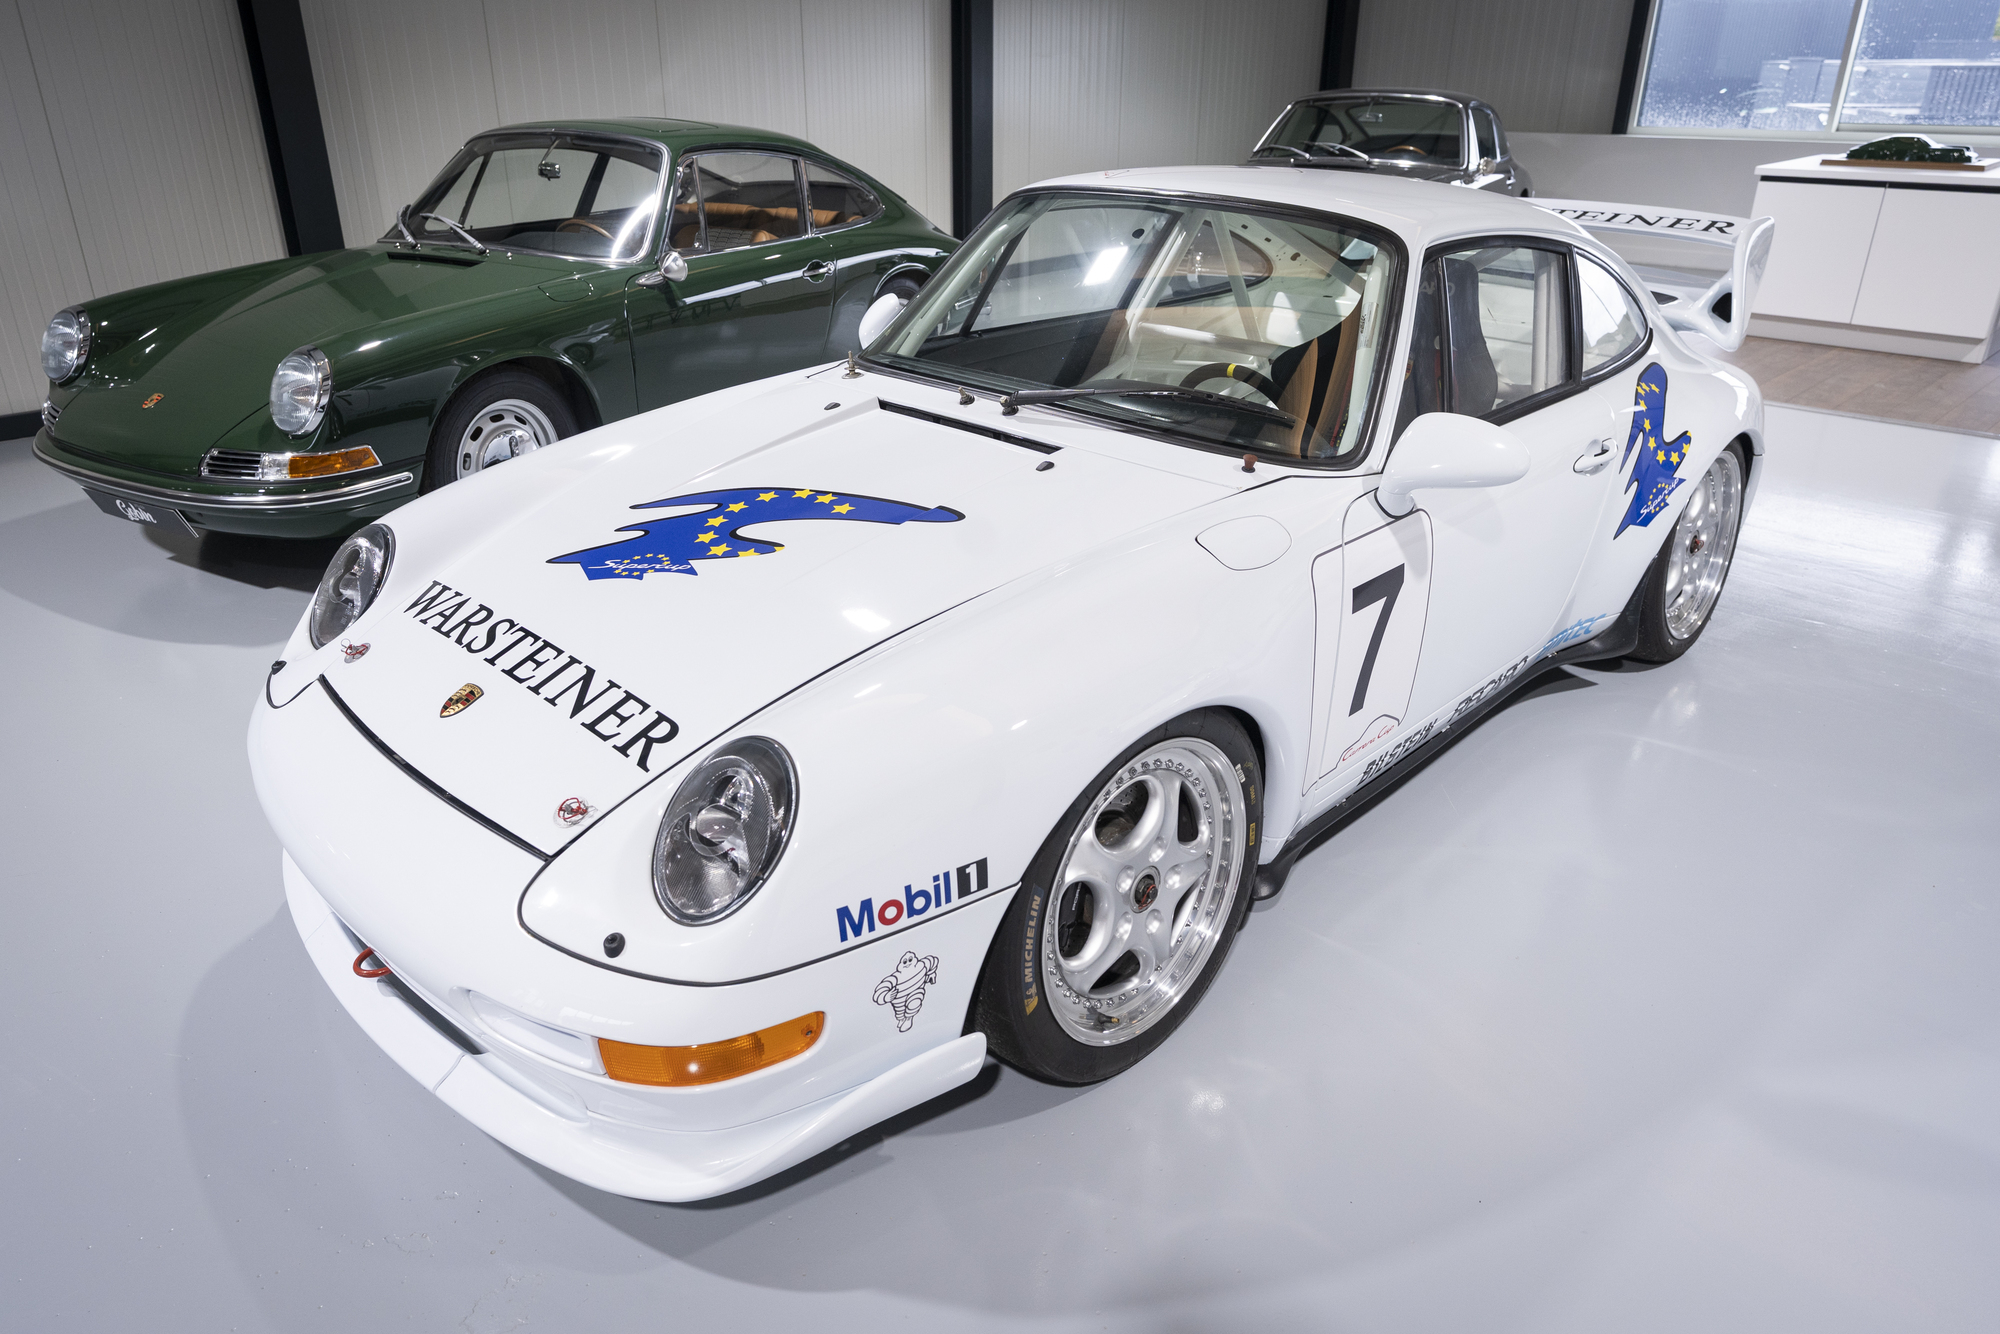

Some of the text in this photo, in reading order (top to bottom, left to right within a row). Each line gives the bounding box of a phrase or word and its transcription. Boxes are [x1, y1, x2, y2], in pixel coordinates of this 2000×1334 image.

[1636, 477, 1680, 523] Supercup
[588, 559, 691, 572] Supercup
[1348, 562, 1405, 717] 7
[403, 579, 680, 773] WARSTEINER
[1342, 724, 1395, 762] Carrera Cup
[1356, 717, 1438, 787] BILSTEIN
[836, 870, 952, 943] Mobil
[1023, 894, 1041, 984] MICHELIN
